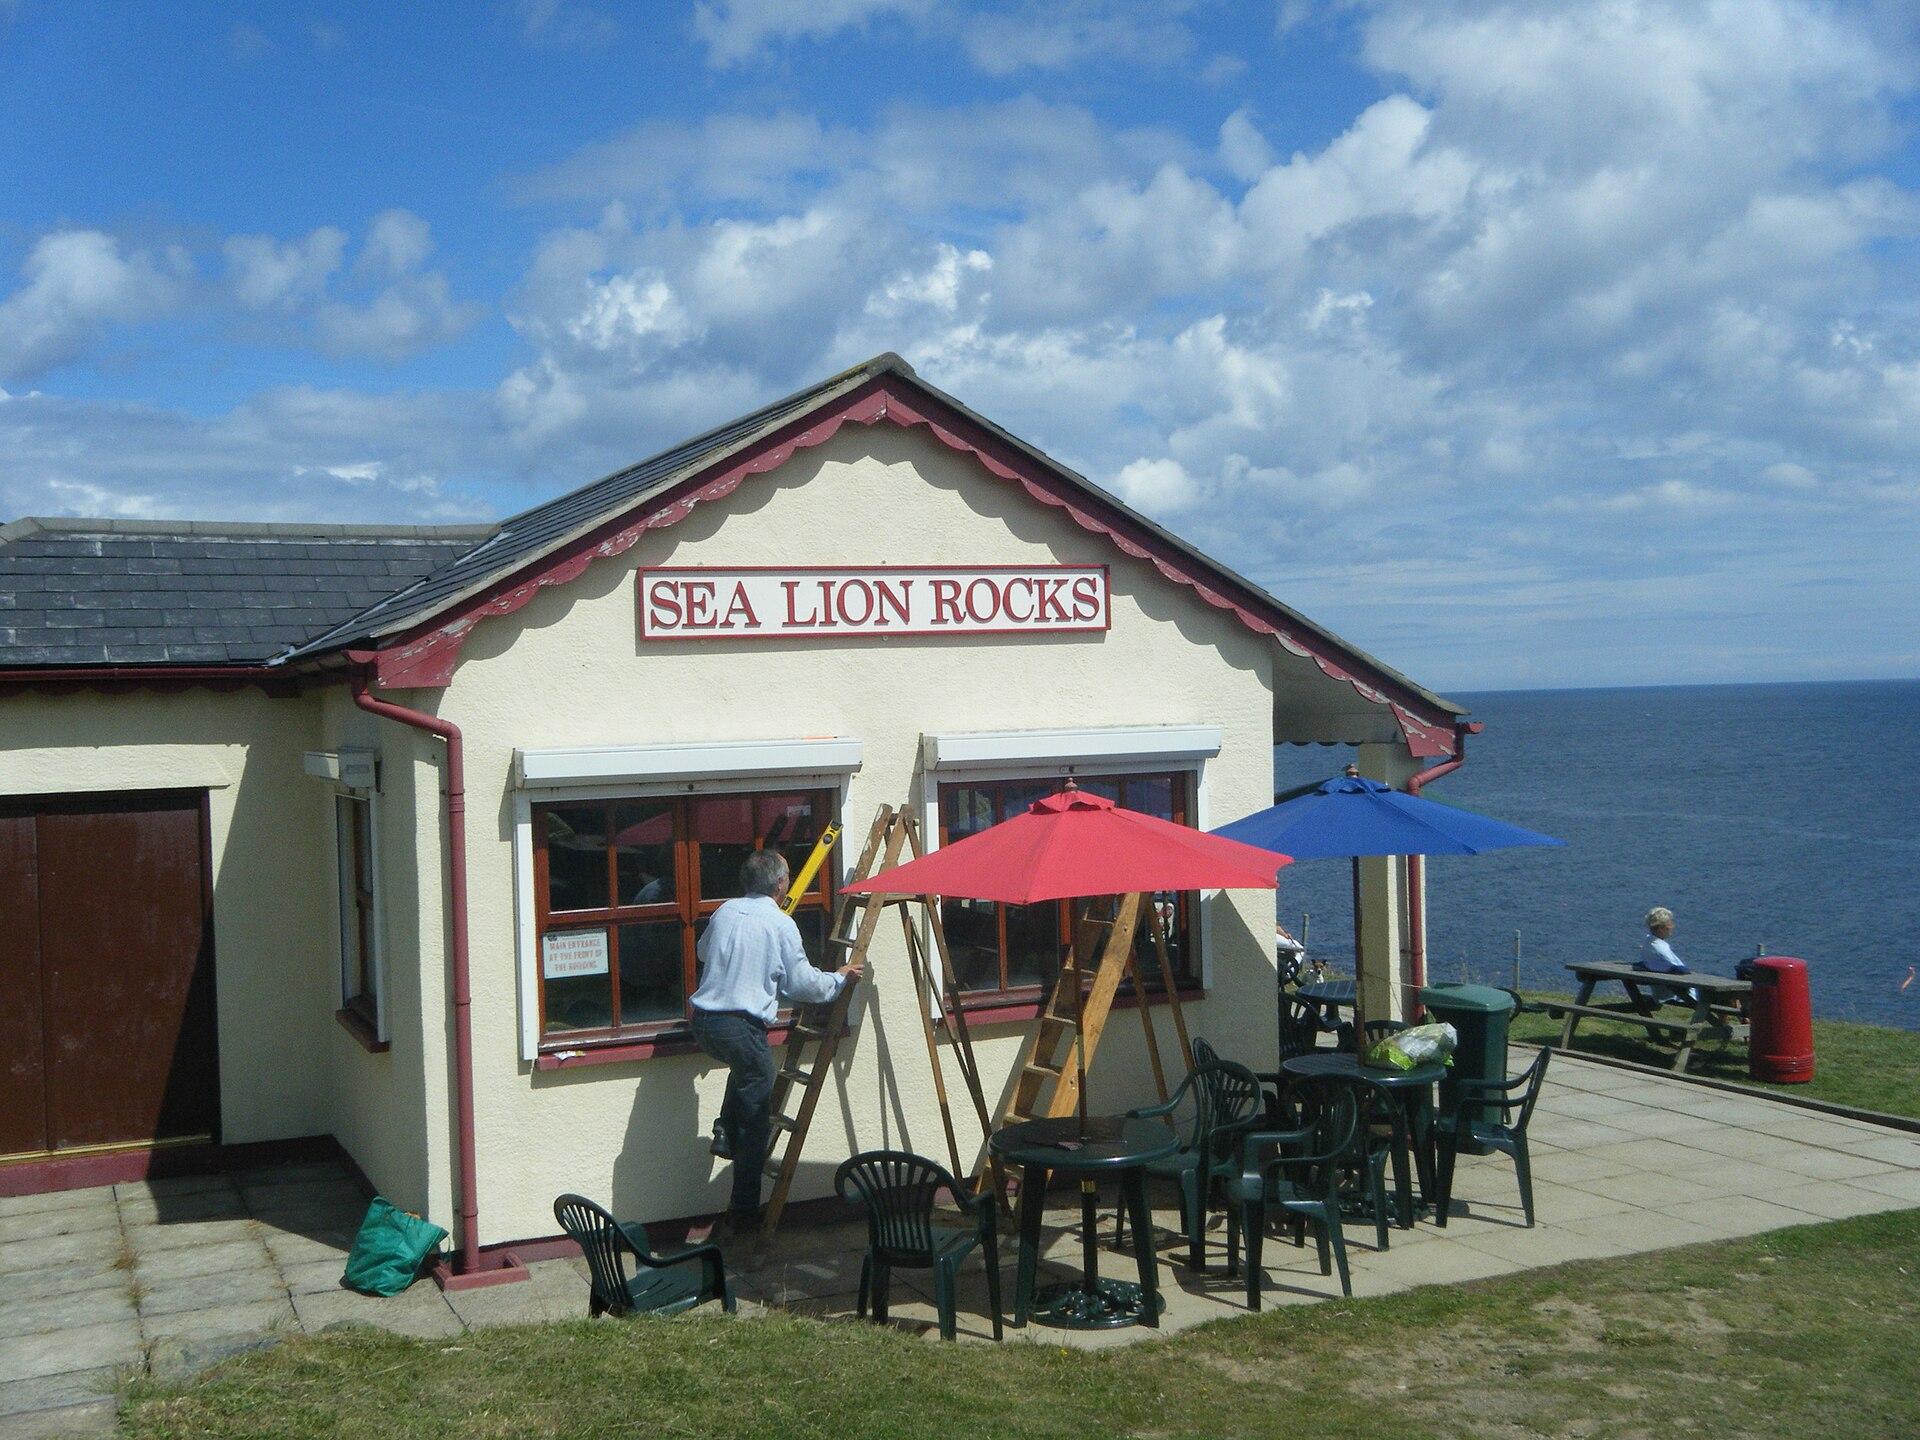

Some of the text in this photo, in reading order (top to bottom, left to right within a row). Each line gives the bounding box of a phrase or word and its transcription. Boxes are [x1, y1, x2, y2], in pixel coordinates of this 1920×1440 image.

[650, 577, 1101, 629] SEA LION ROCKS
[550, 939, 601, 950] MAIN ENTRANCE
[560, 952, 572, 961] THE
[574, 950, 593, 960] FRONT
[555, 963, 566, 972] THE
